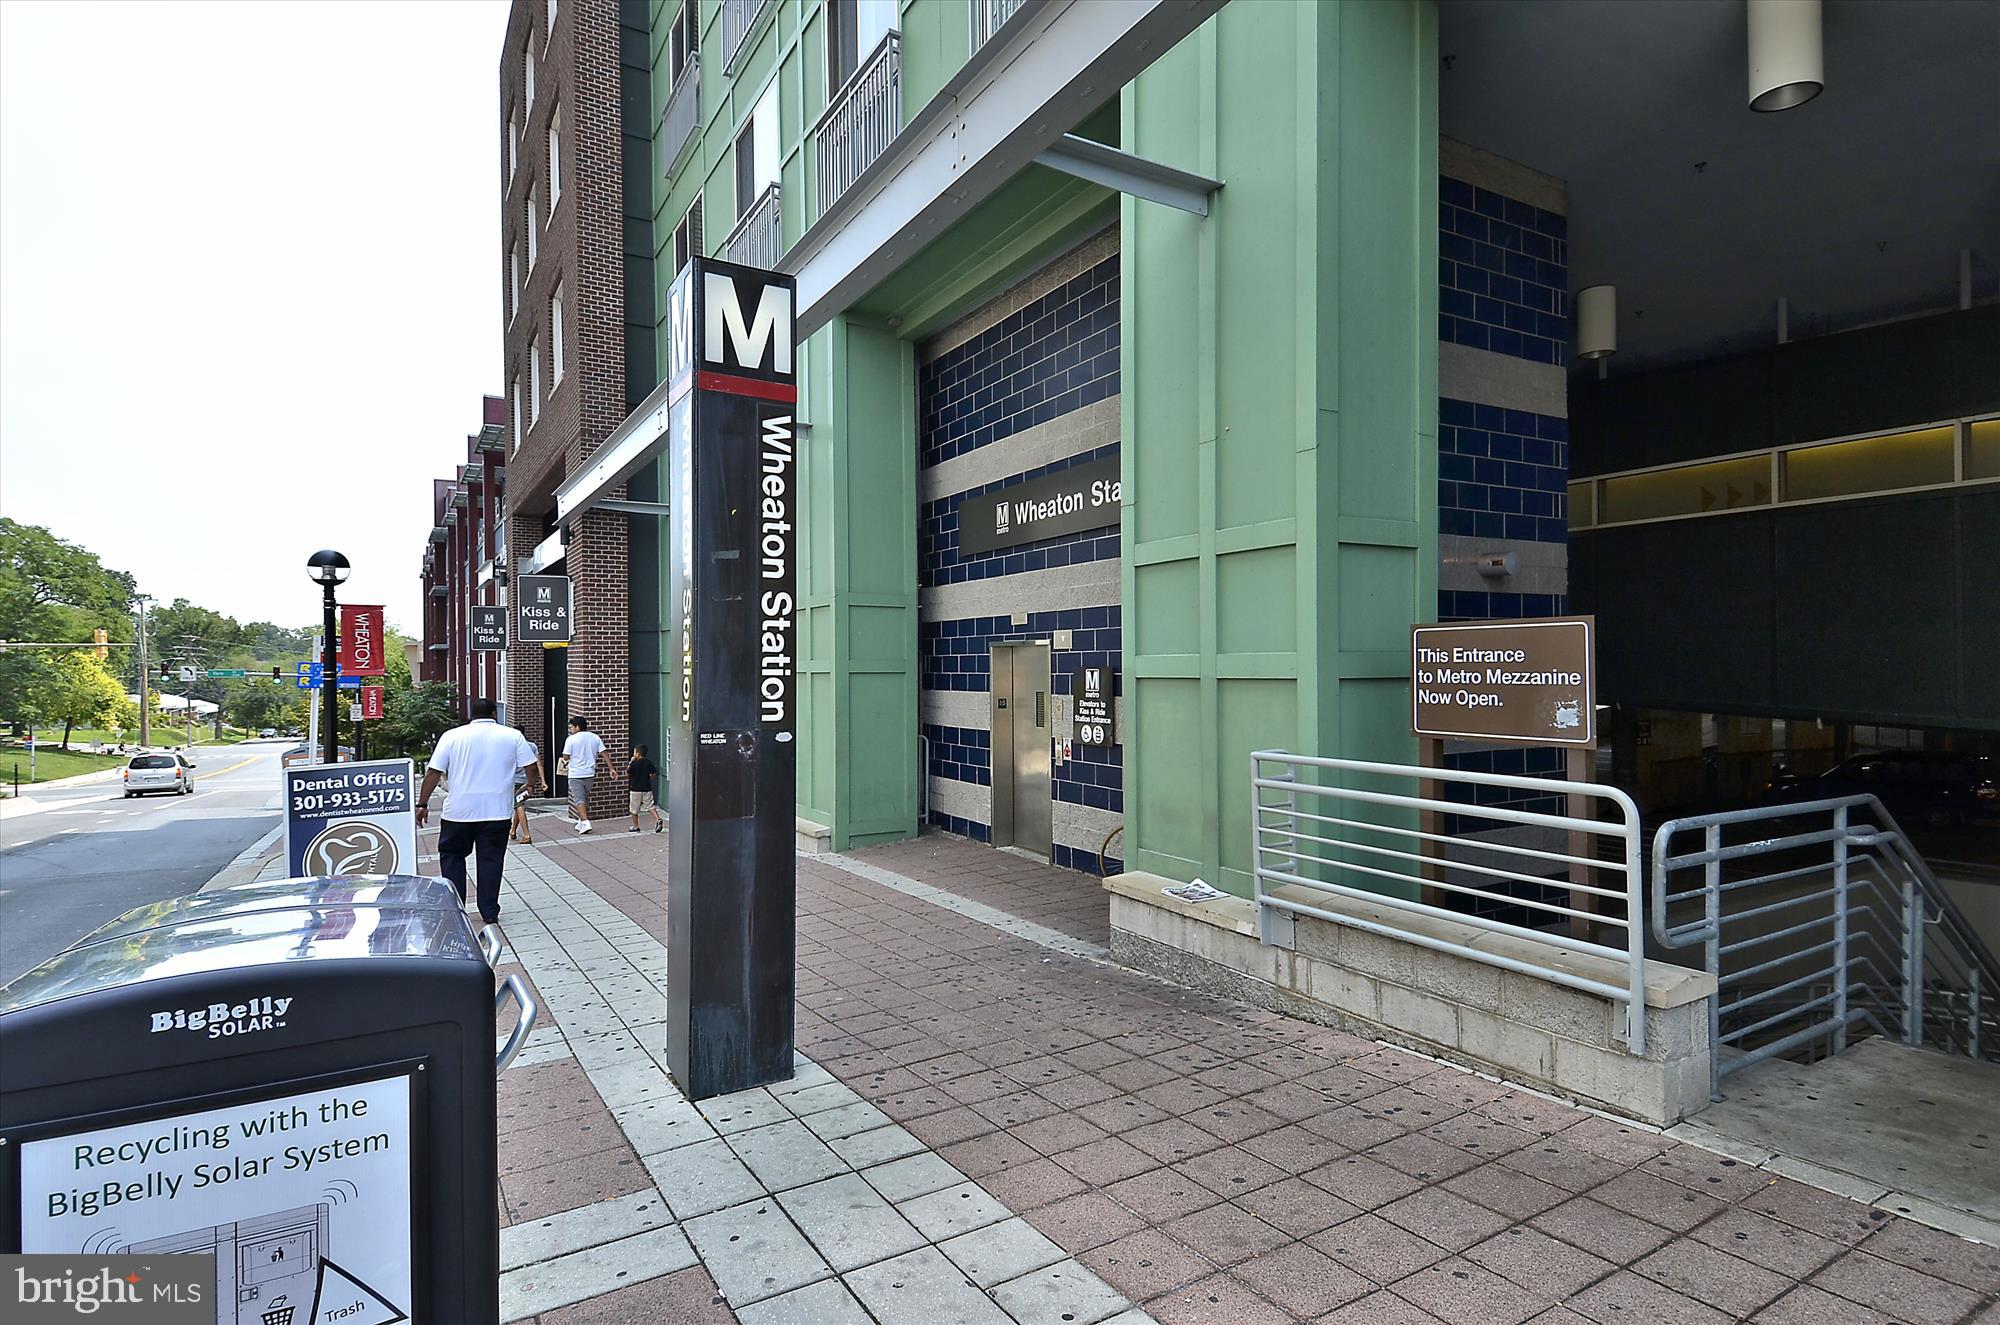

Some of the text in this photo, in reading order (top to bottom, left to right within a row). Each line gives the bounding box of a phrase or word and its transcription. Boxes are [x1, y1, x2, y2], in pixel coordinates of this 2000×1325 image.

[705, 271, 792, 374] M
[1015, 491, 1084, 525] Wheaton
[1091, 479, 1121, 507] Sta
[761, 415, 793, 722] Wheaton Station
[521, 606, 567, 617] Kiss &
[474, 626, 505, 635] Kiss &
[529, 619, 560, 631] Ride
[355, 613, 371, 669] WHEATON
[479, 635, 500, 643] Ride
[682, 588, 692, 722] Station
[1418, 647, 1525, 663] This Entrance
[1418, 668, 1582, 685] to Metro Mezzanine
[1418, 690, 1504, 708] Now Open.
[1095, 708, 1106, 716] Ride
[293, 772, 405, 792] Dental Office
[294, 788, 405, 811] 301-933-5175
[300, 805, 400, 819] www.dentistwheatonmd.com
[150, 996, 293, 1033] BigBelly
[208, 1015, 274, 1039] SOLAR
[74, 1098, 368, 1170] Recycling with the
[48, 1132, 389, 1217] BigBelly Solar System
[325, 1300, 365, 1323] Trash
